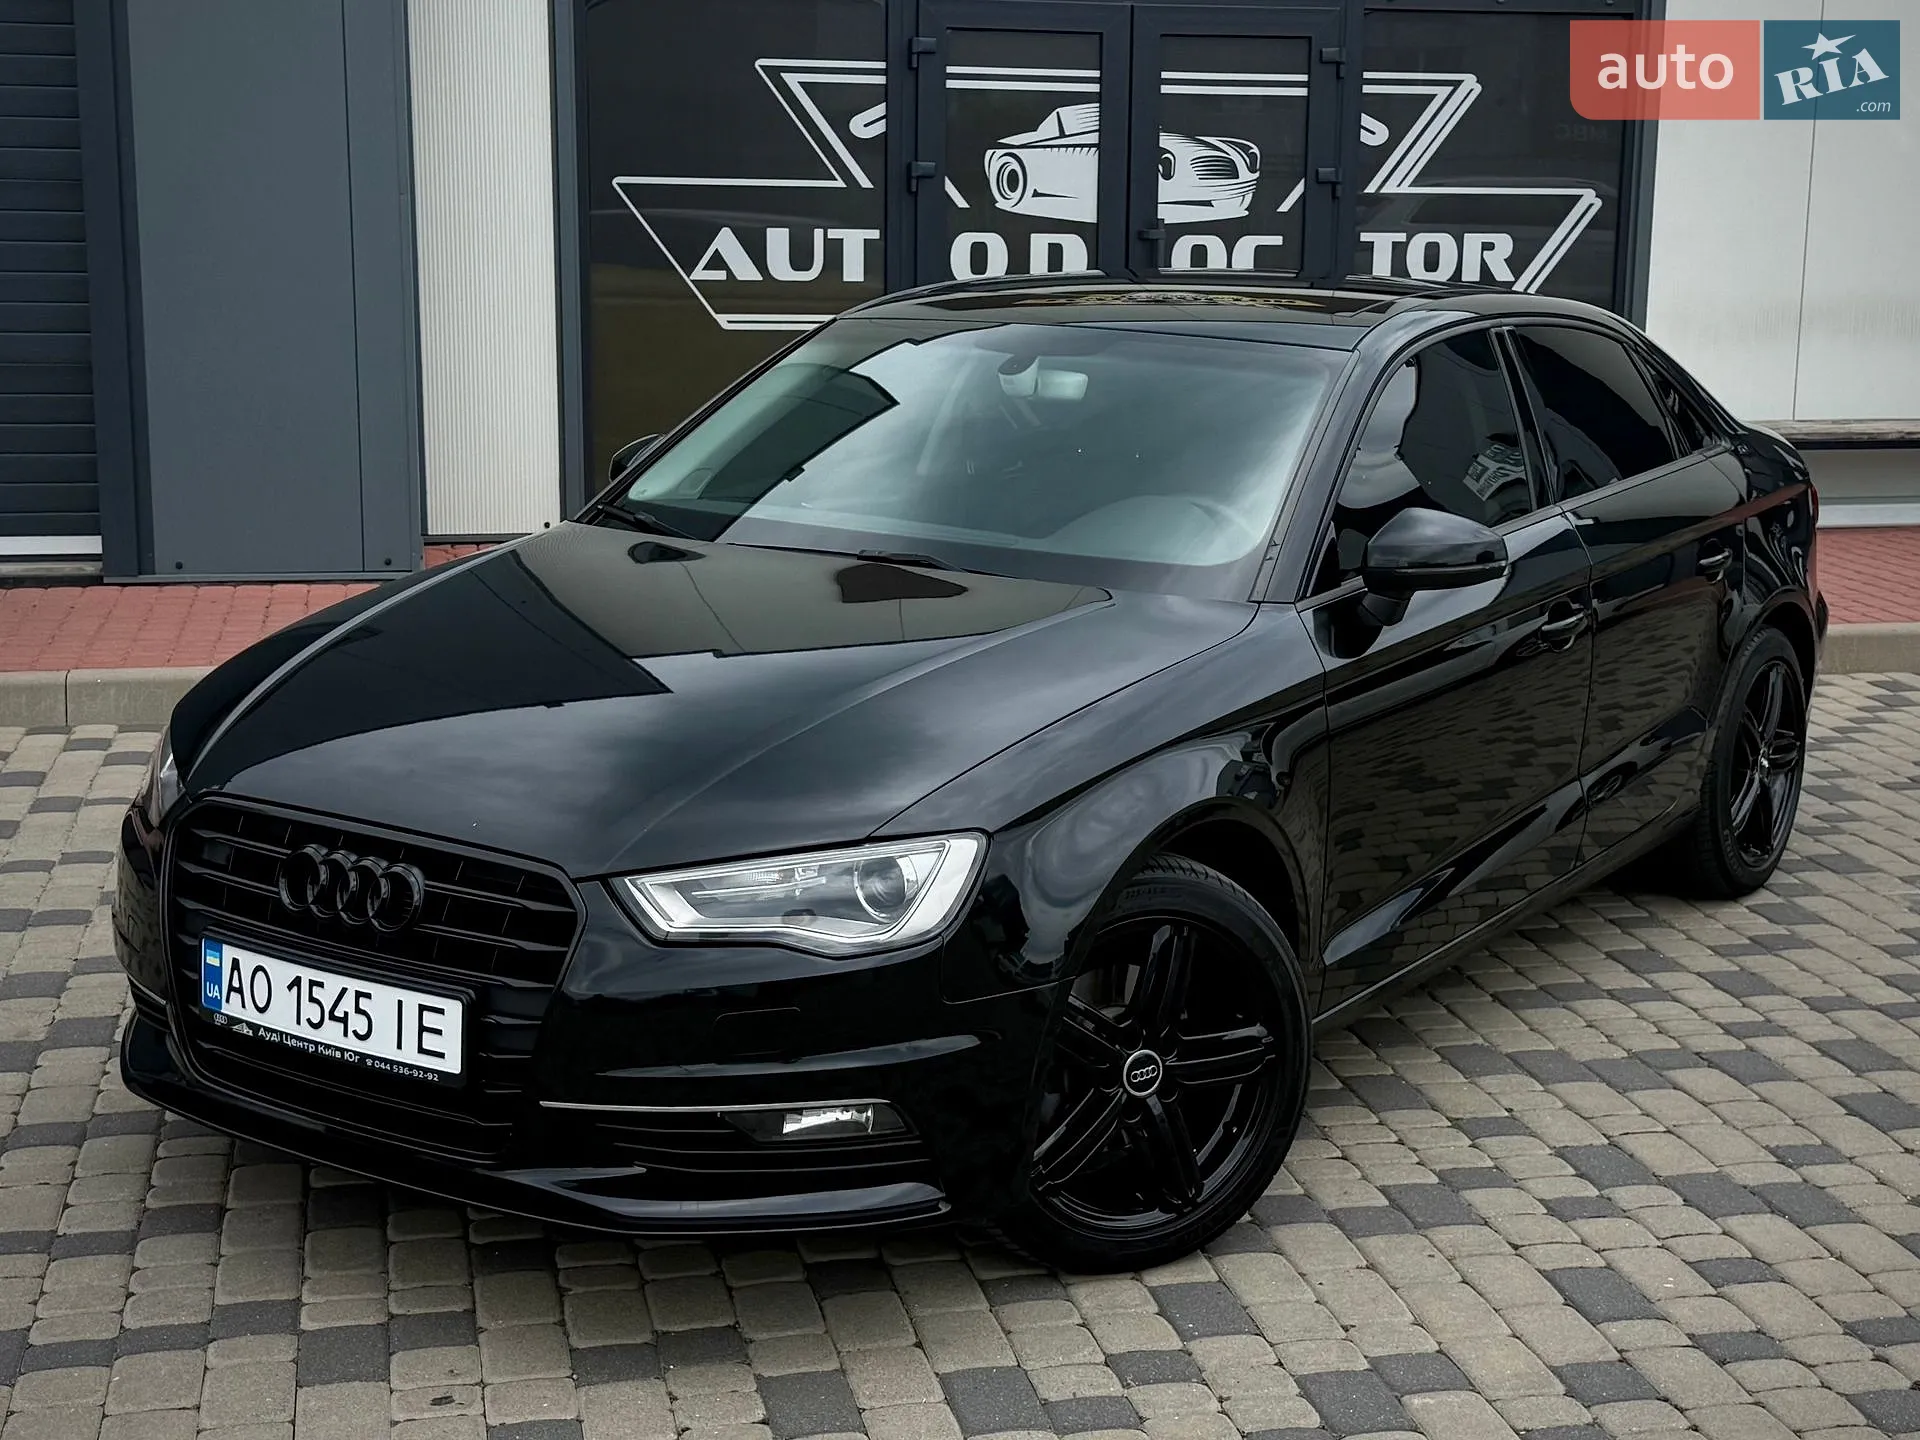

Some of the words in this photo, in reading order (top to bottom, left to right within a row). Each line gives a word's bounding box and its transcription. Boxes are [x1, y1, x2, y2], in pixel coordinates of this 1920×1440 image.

[206, 981, 221, 1000] UA
[225, 957, 273, 1014] AO
[286, 975, 374, 1041] 1545
[396, 998, 446, 1060] IE
[258, 1027, 281, 1043] Ауді
[283, 1033, 316, 1053] Центр
[318, 1044, 341, 1060] Київ
[344, 1051, 360, 1064] Юг
[374, 1060, 391, 1072] 044
[393, 1064, 440, 1082] 536-92-92
